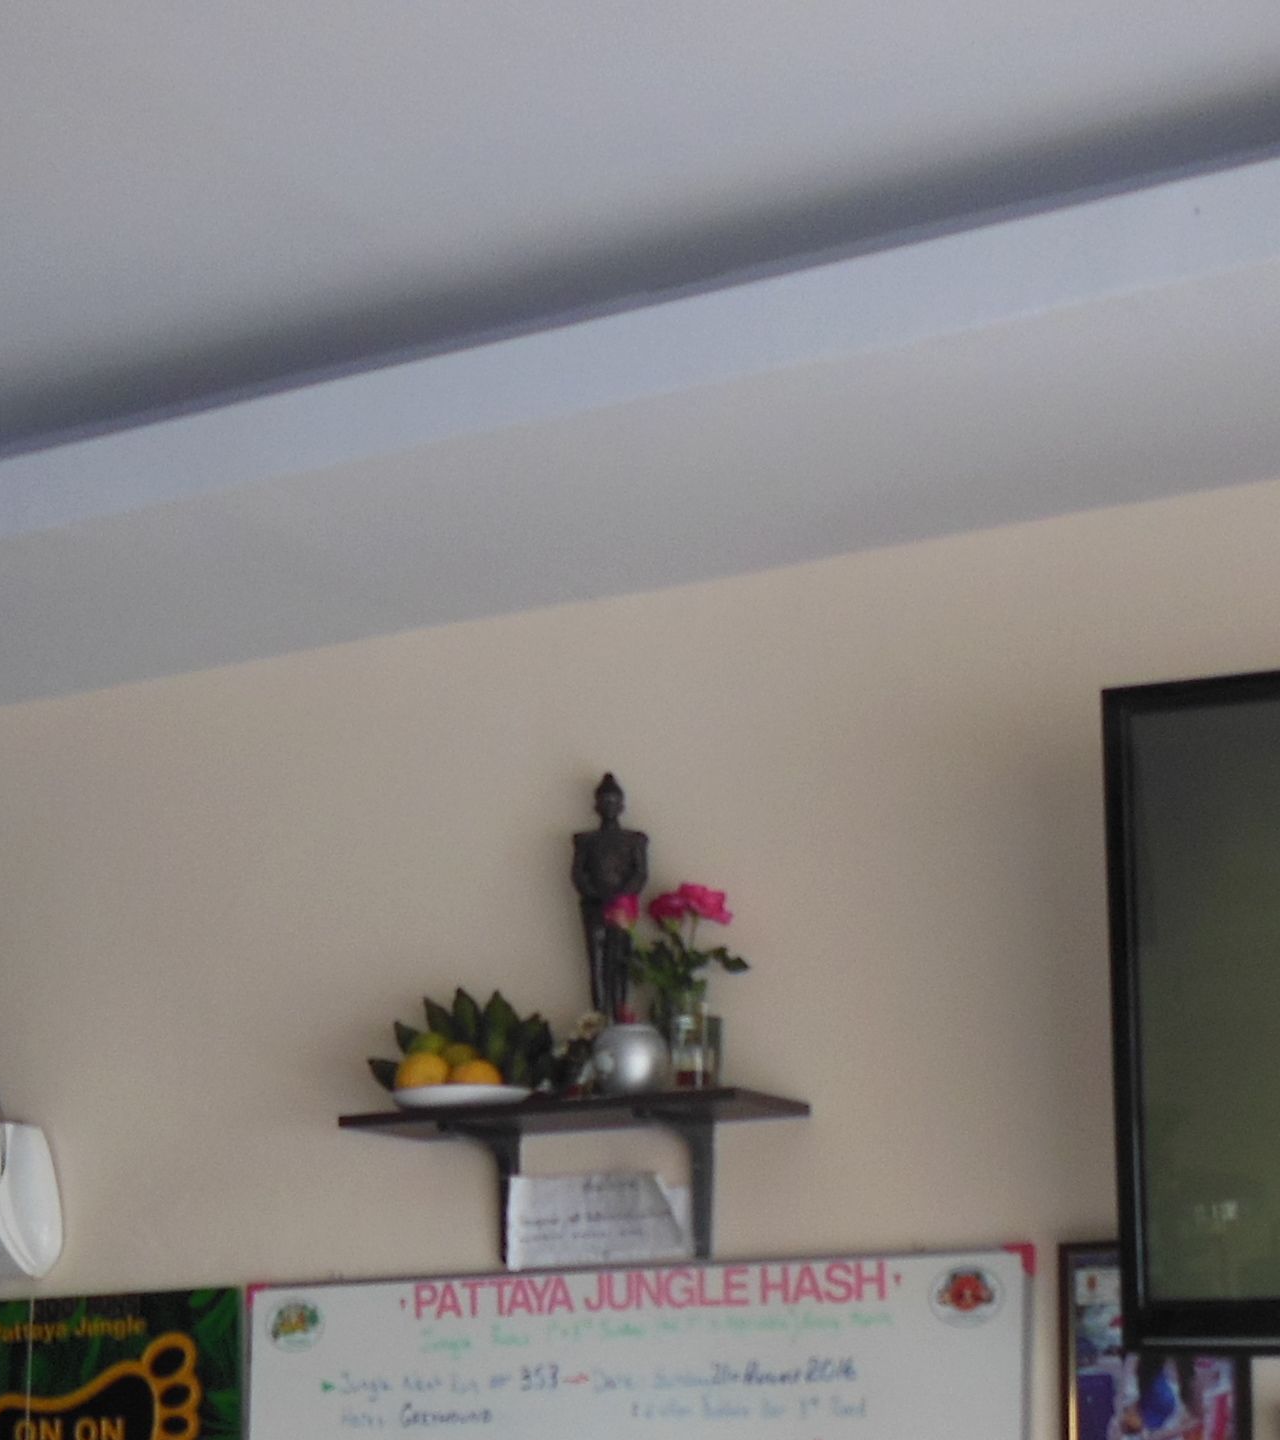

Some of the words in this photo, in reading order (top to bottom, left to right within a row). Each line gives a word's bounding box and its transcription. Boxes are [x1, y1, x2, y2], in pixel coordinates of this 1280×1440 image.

[413, 1275, 575, 1320] PATTAYA
[583, 1265, 751, 1313] JUNGLE
[760, 1259, 888, 1306] HASH
[74, 1314, 148, 1340] Jungle
